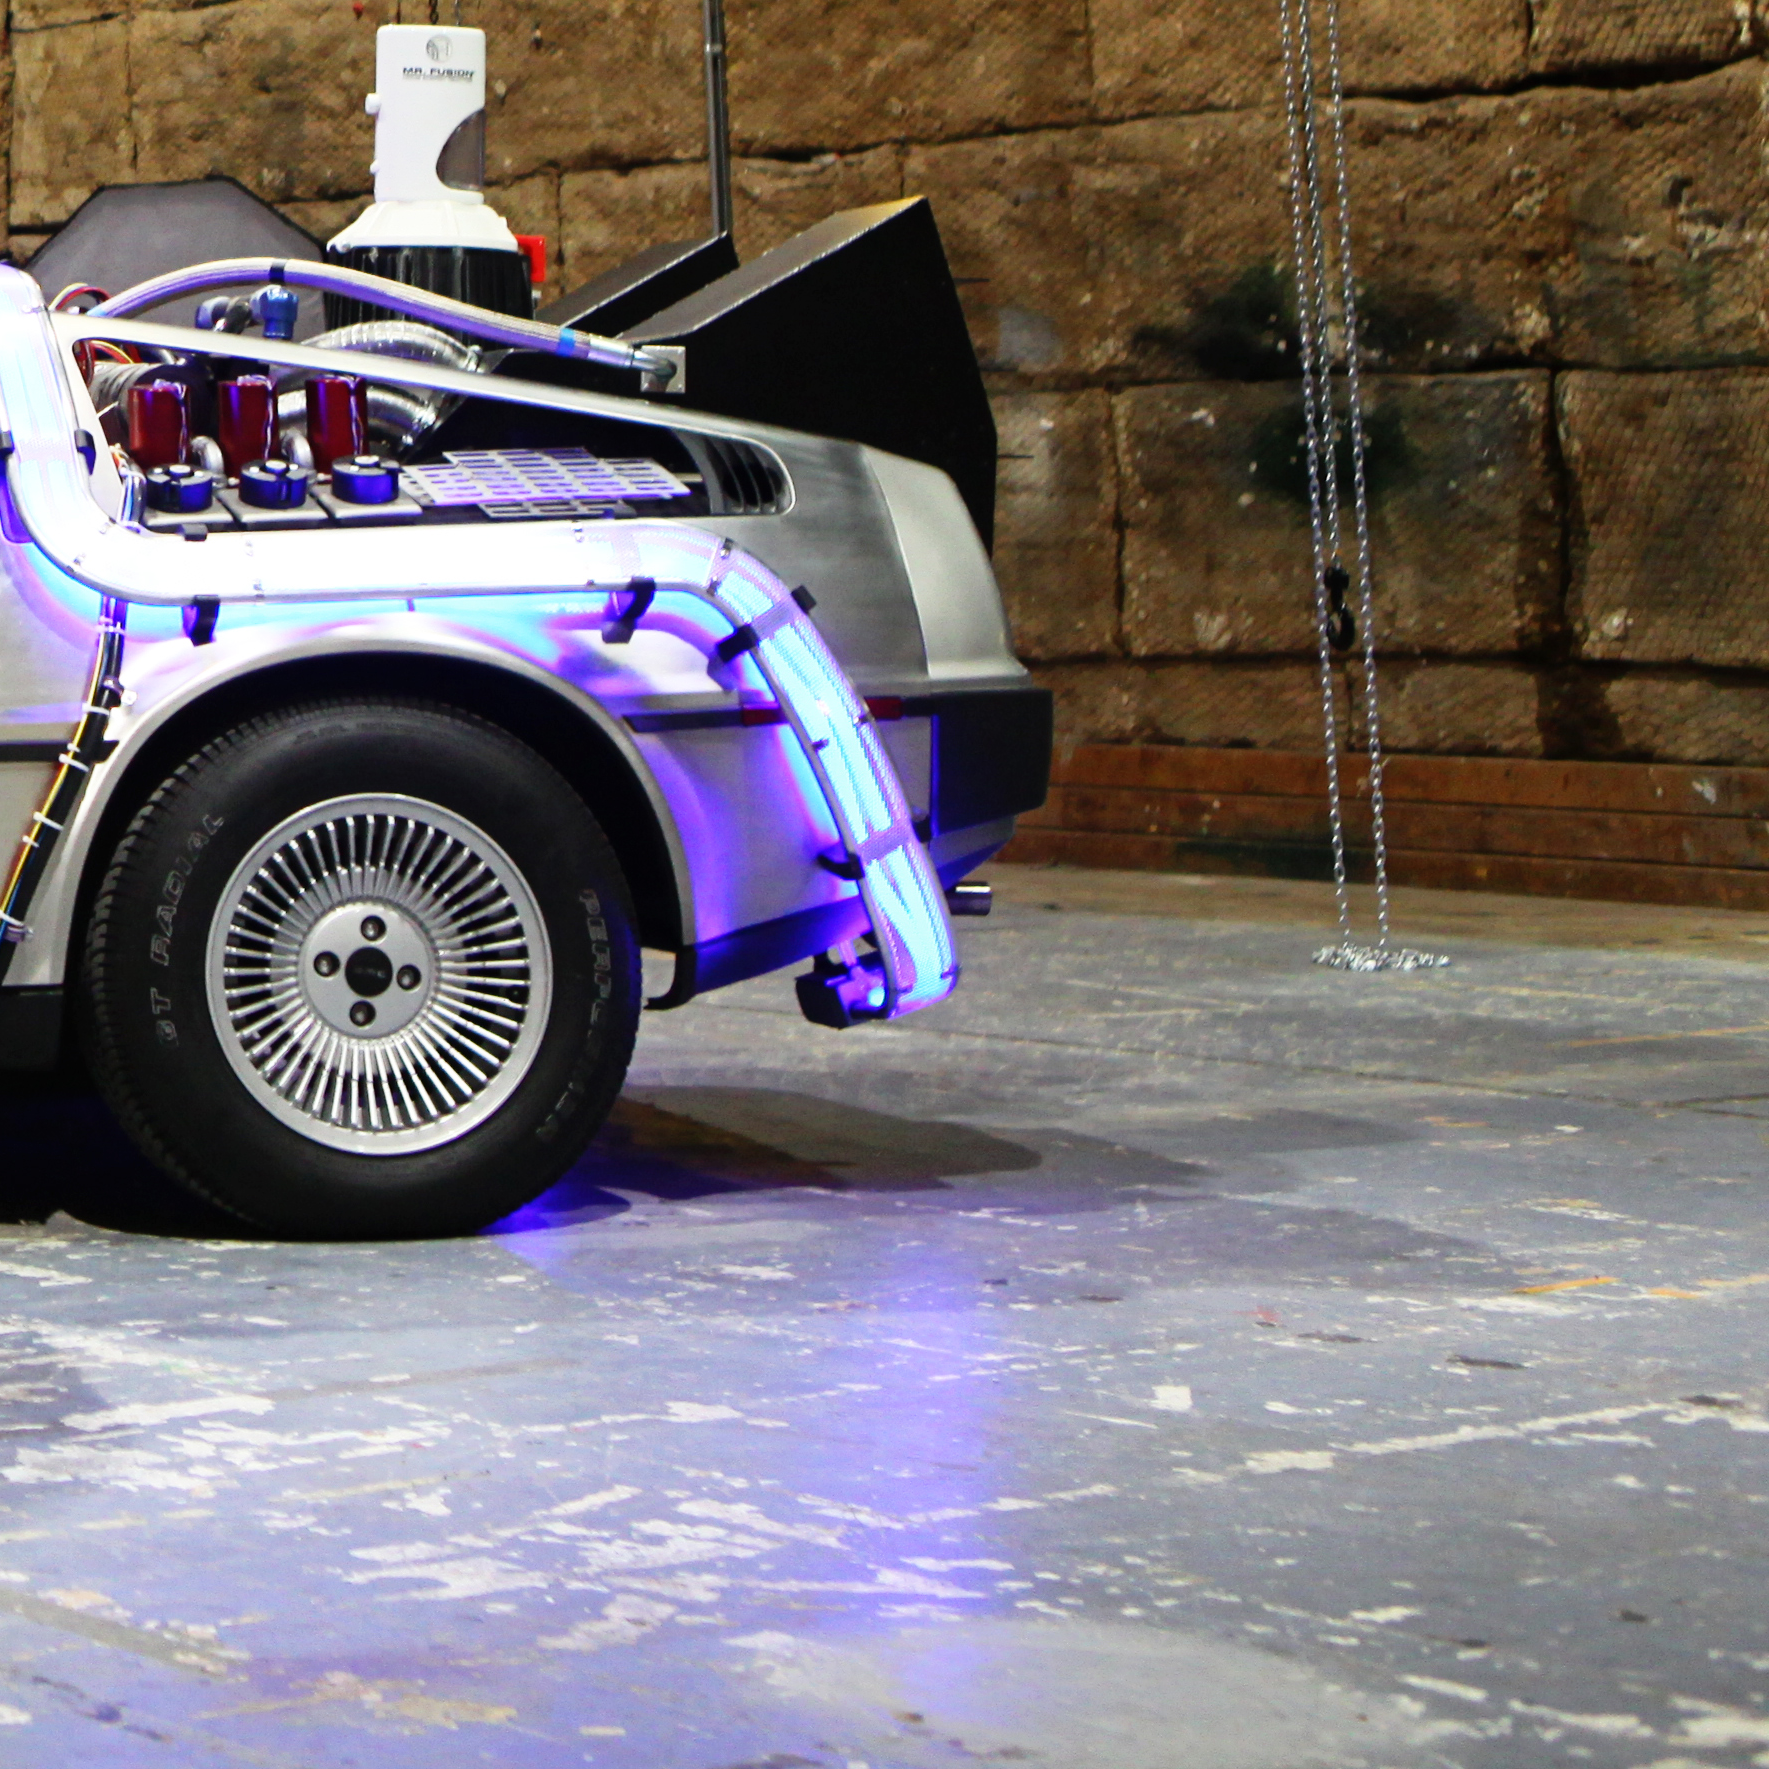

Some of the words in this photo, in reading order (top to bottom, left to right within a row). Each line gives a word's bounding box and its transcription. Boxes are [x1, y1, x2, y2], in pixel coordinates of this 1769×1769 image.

[430, 68, 476, 78] FUSION
[150, 814, 224, 967] RADIAL
[535, 888, 612, 1142] PERFOMER
